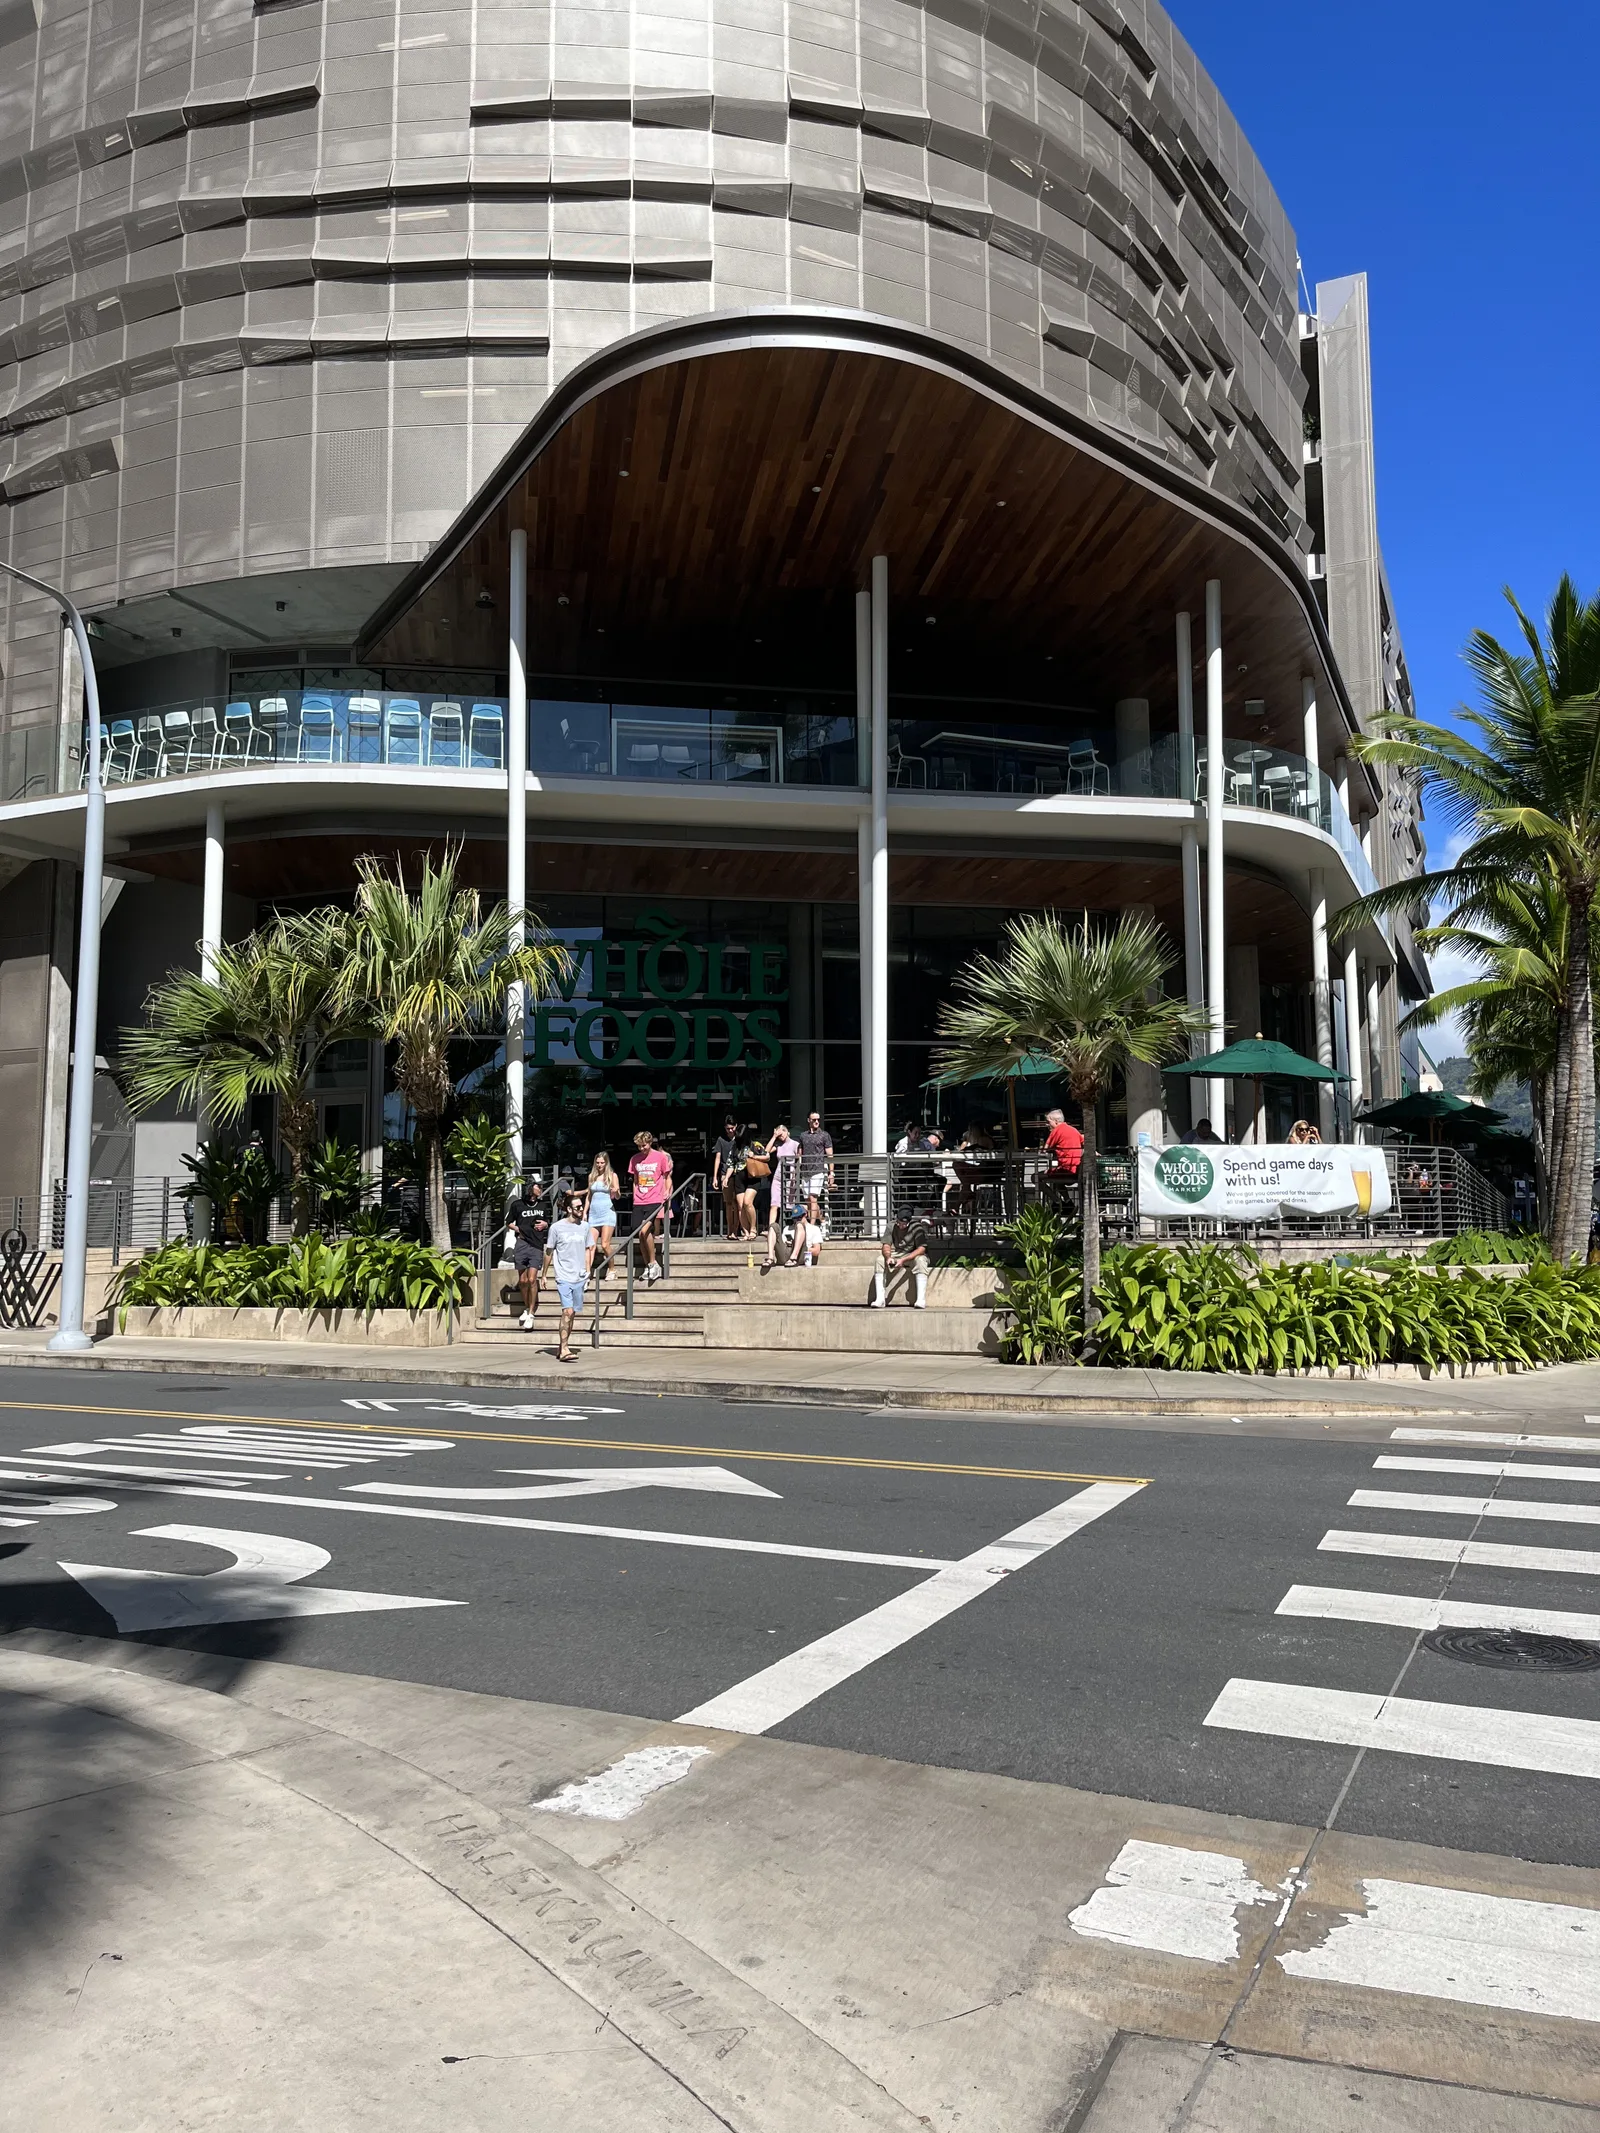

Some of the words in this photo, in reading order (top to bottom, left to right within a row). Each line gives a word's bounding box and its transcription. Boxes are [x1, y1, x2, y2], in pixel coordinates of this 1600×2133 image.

[508, 938, 790, 1001] WHOLE
[529, 1006, 783, 1069] FOODS
[560, 1084, 744, 1107] MARKET
[1160, 1162, 1209, 1174] WHOLE
[1223, 1158, 1266, 1174] Spend
[1269, 1160, 1305, 1172] game
[1308, 1157, 1334, 1173] days
[1163, 1174, 1208, 1186] FOODS
[1225, 1173, 1257, 1187] with
[1260, 1172, 1281, 1185] us!
[521, 1209, 545, 1218] CELINE
[420, 1812, 749, 2061] HALEKAUWILA
